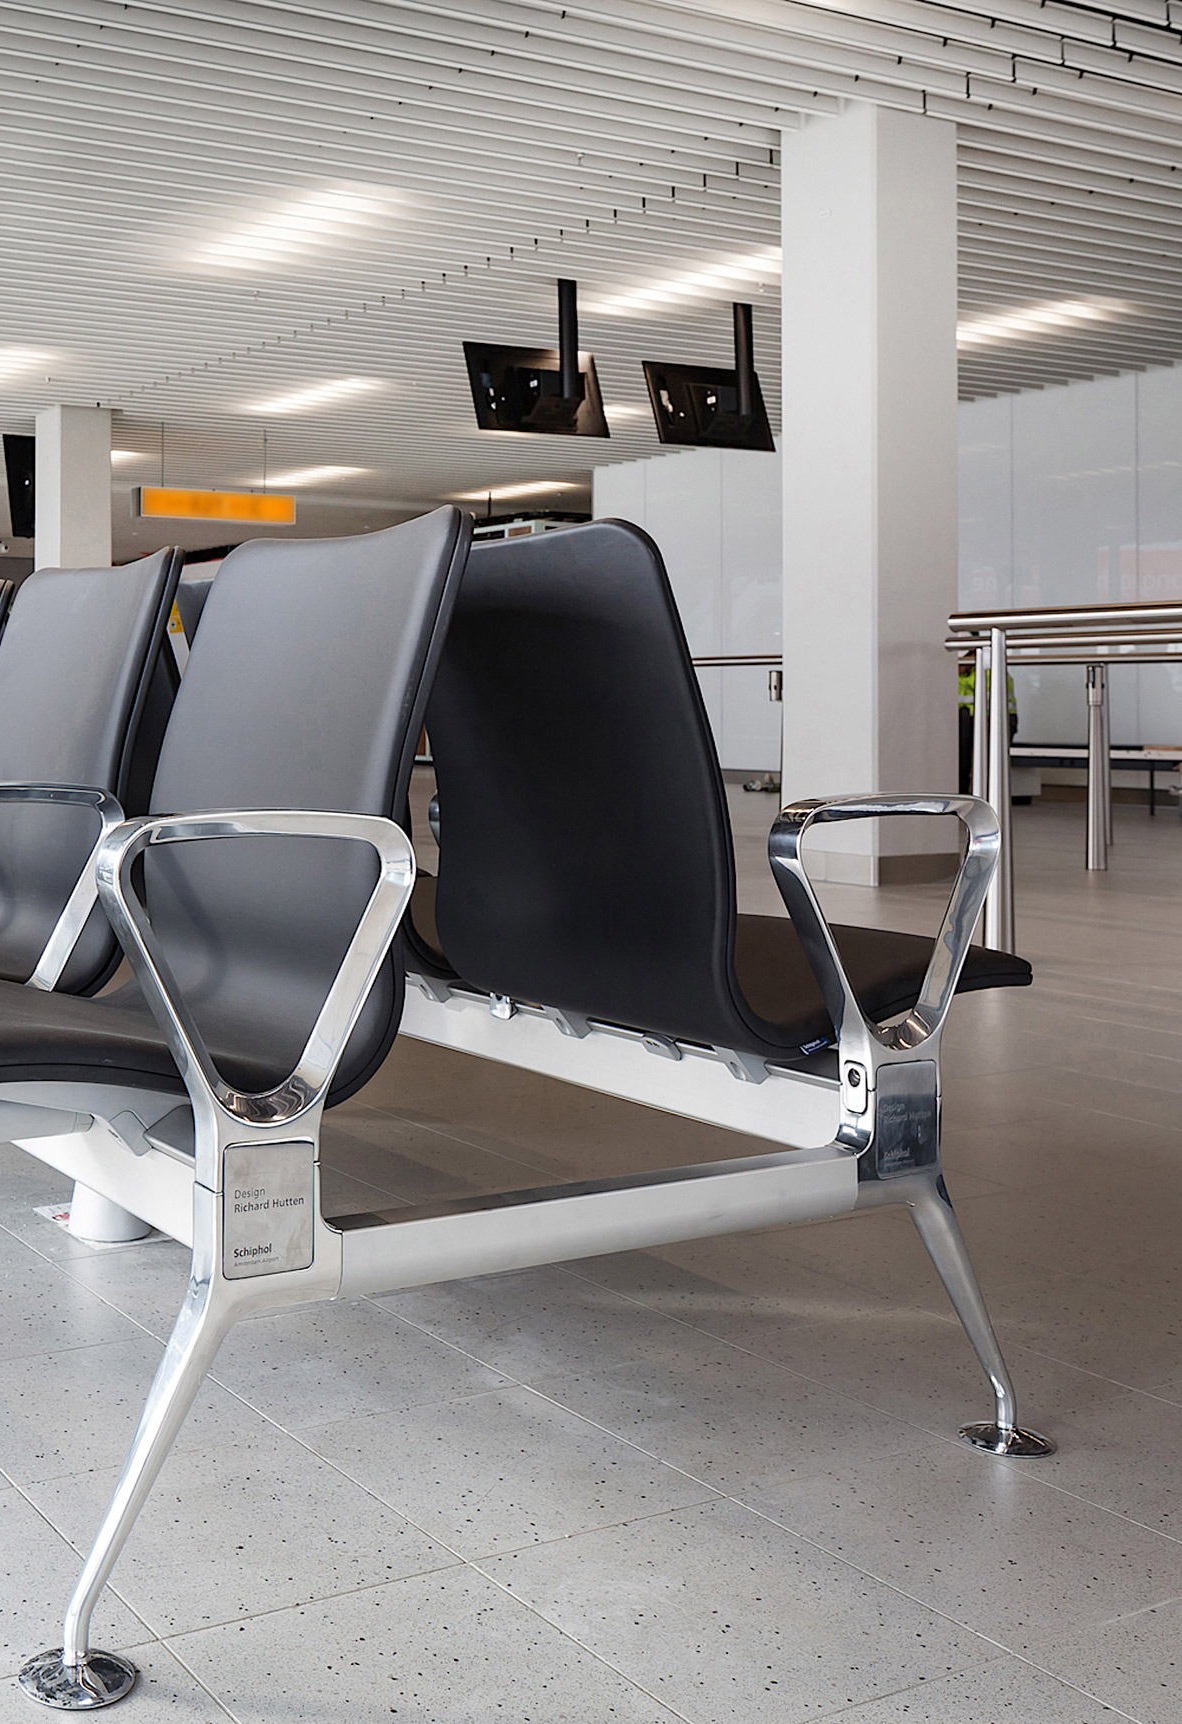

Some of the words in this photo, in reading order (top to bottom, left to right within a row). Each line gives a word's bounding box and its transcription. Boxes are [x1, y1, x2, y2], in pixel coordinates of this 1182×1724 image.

[234, 1187, 266, 1199] Design
[234, 1199, 270, 1213] Richard
[272, 1197, 305, 1209] Hutten
[233, 1243, 272, 1258] Schiphol
